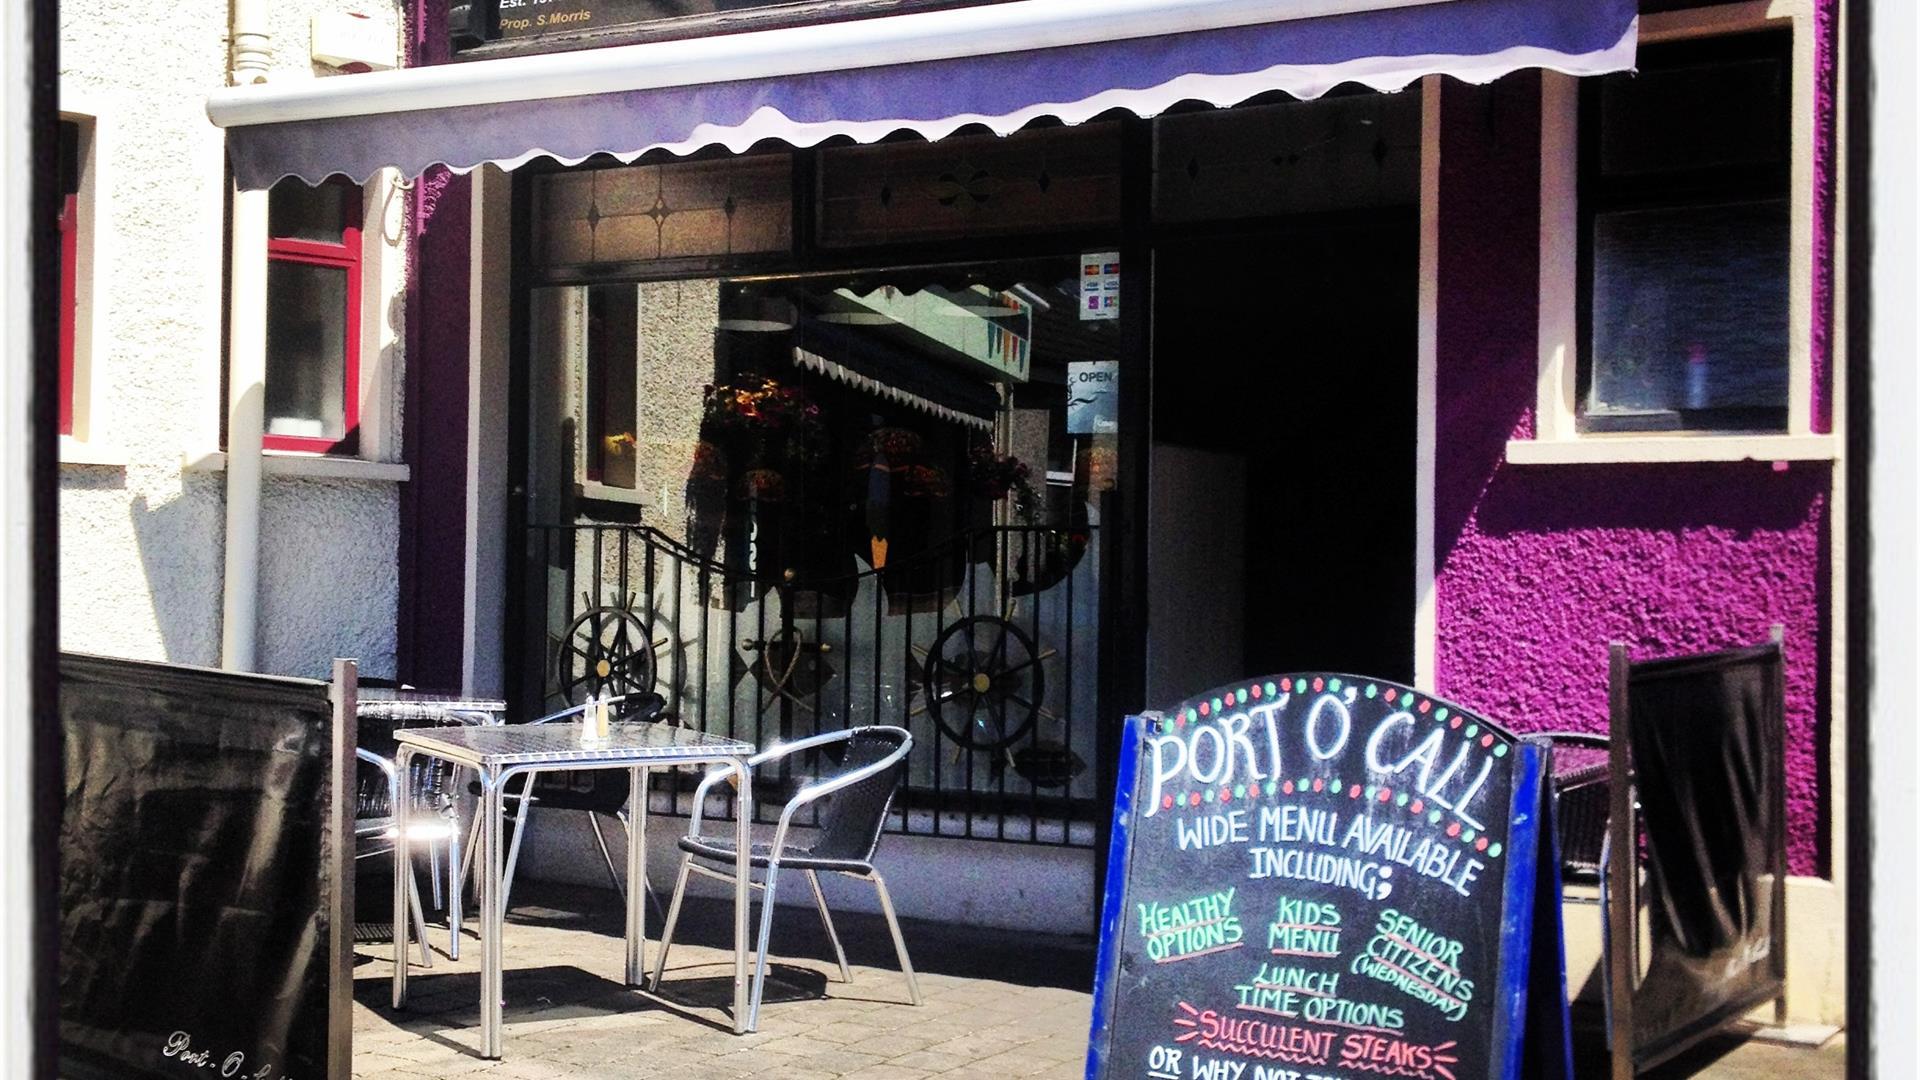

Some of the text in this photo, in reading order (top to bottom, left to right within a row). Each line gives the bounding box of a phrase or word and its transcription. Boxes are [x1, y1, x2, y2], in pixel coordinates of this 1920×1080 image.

[500, 18, 532, 30] Prop.
[1079, 371, 1113, 383] OPEN
[1144, 694, 1290, 817] PORT
[1366, 712, 1495, 831] CALL
[1177, 805, 1485, 897] WIDE MENU AVAILABLE
[1138, 887, 1236, 936] HEALTHY
[1279, 896, 1342, 925] KIDS
[1147, 917, 1244, 960] OPTIONS
[1268, 922, 1341, 954] MENU
[1376, 908, 1464, 973] SENIOR
[1252, 962, 1340, 994] LUNCH
[1350, 953, 1468, 1021] (WEDNESDAY)
[1367, 934, 1475, 1001] CITIZENS
[1234, 985, 1405, 1029] TIME OPTIONS
[1200, 1010, 1432, 1070] SUCCULENT STEAKS
[1149, 1045, 1182, 1074] OR
[1192, 1055, 1246, 1080] WHY
